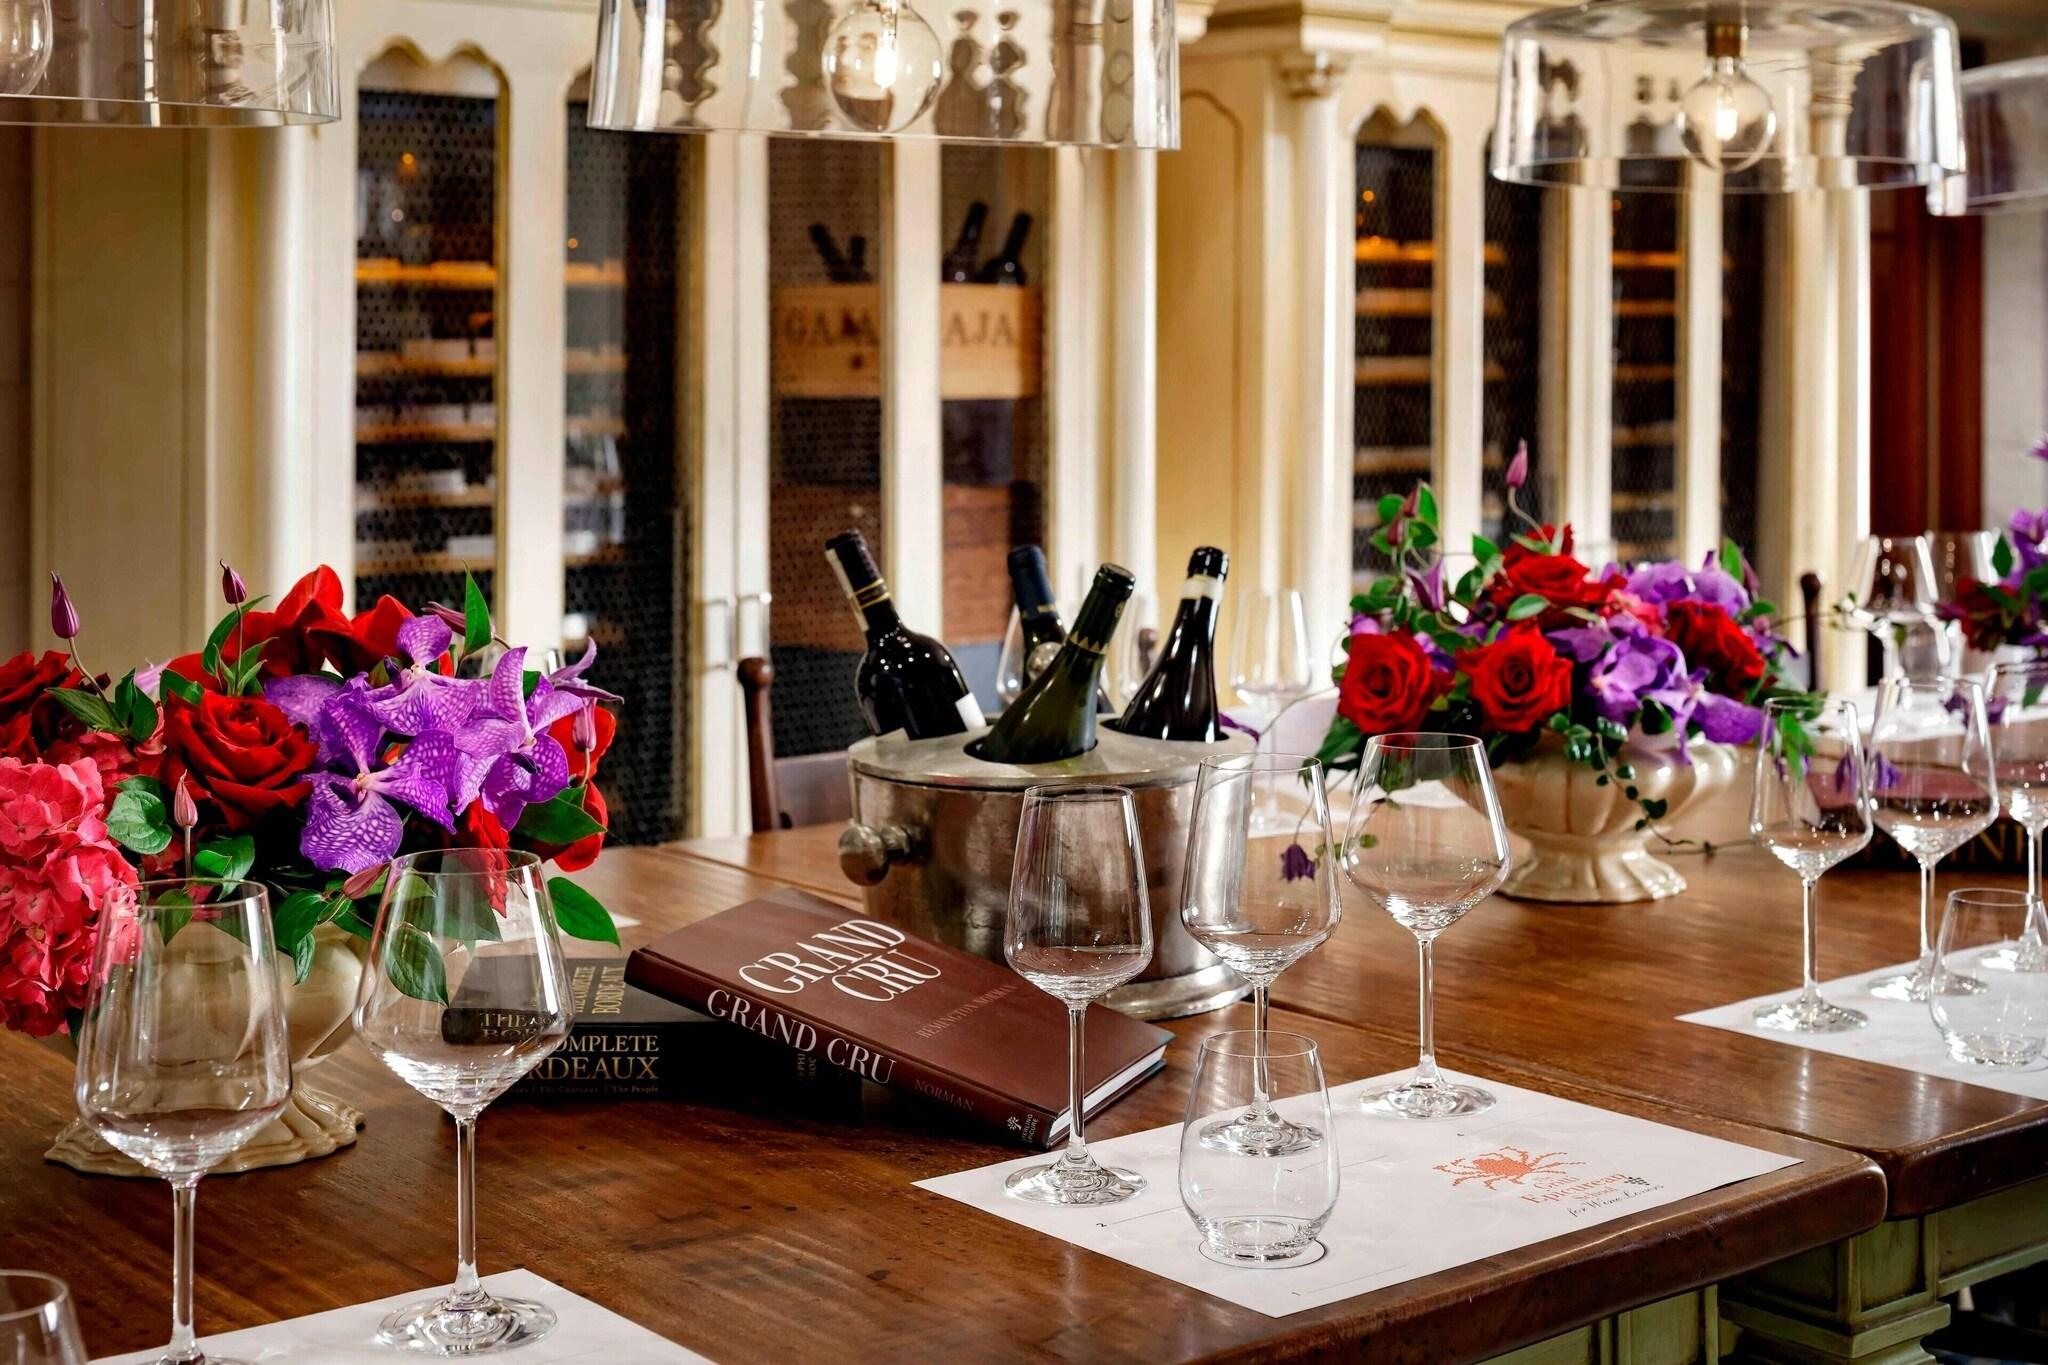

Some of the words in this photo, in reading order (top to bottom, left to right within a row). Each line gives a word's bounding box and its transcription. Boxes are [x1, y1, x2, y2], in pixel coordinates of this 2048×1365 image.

[939, 311, 1018, 347] AJA
[738, 919, 907, 994] GRAND
[831, 949, 942, 1002] CRU
[707, 989, 817, 1052] GRAND
[827, 1037, 897, 1084] CRU
[526, 1057, 660, 1080] RDEAUX
[914, 1078, 974, 1111] NORMAN
[1521, 1173, 1628, 1203] Epicurean
